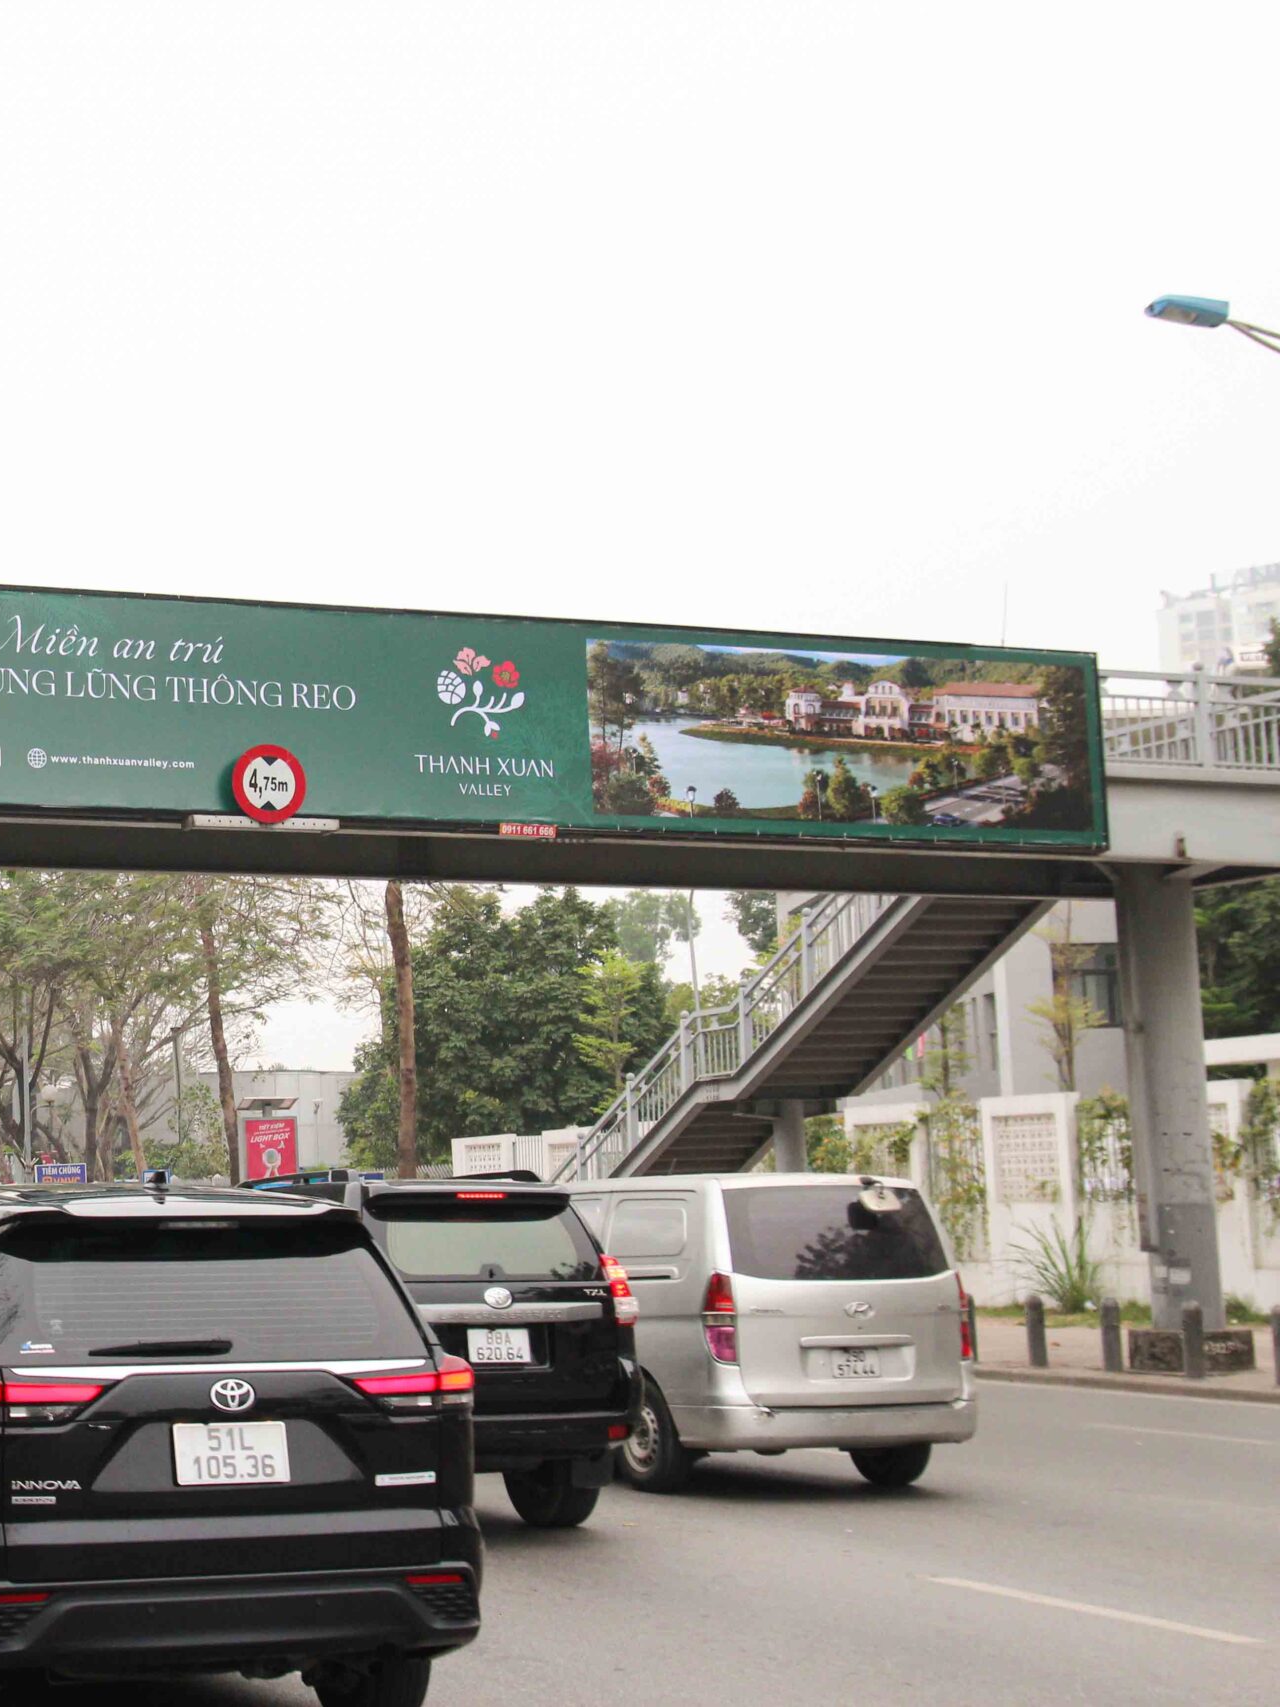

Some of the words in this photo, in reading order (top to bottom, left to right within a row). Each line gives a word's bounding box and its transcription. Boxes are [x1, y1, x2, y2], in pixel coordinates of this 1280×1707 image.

[113, 636, 156, 660] an
[169, 635, 224, 664] trú
[65, 668, 156, 701] LŨNG
[165, 673, 283, 707] THÔNG
[291, 682, 357, 711] REO
[50, 754, 195, 770] www.thanhxuanvalley.com
[414, 754, 490, 775] THANH
[497, 757, 555, 778] XUAN
[248, 767, 289, 799] 4,75m
[459, 783, 512, 797] VALLEY
[476, 1347, 524, 1361] 620.64
[207, 1427, 254, 1452] 51L
[193, 1454, 276, 1480] 105.36
[11, 1480, 82, 1490] INNOVA
